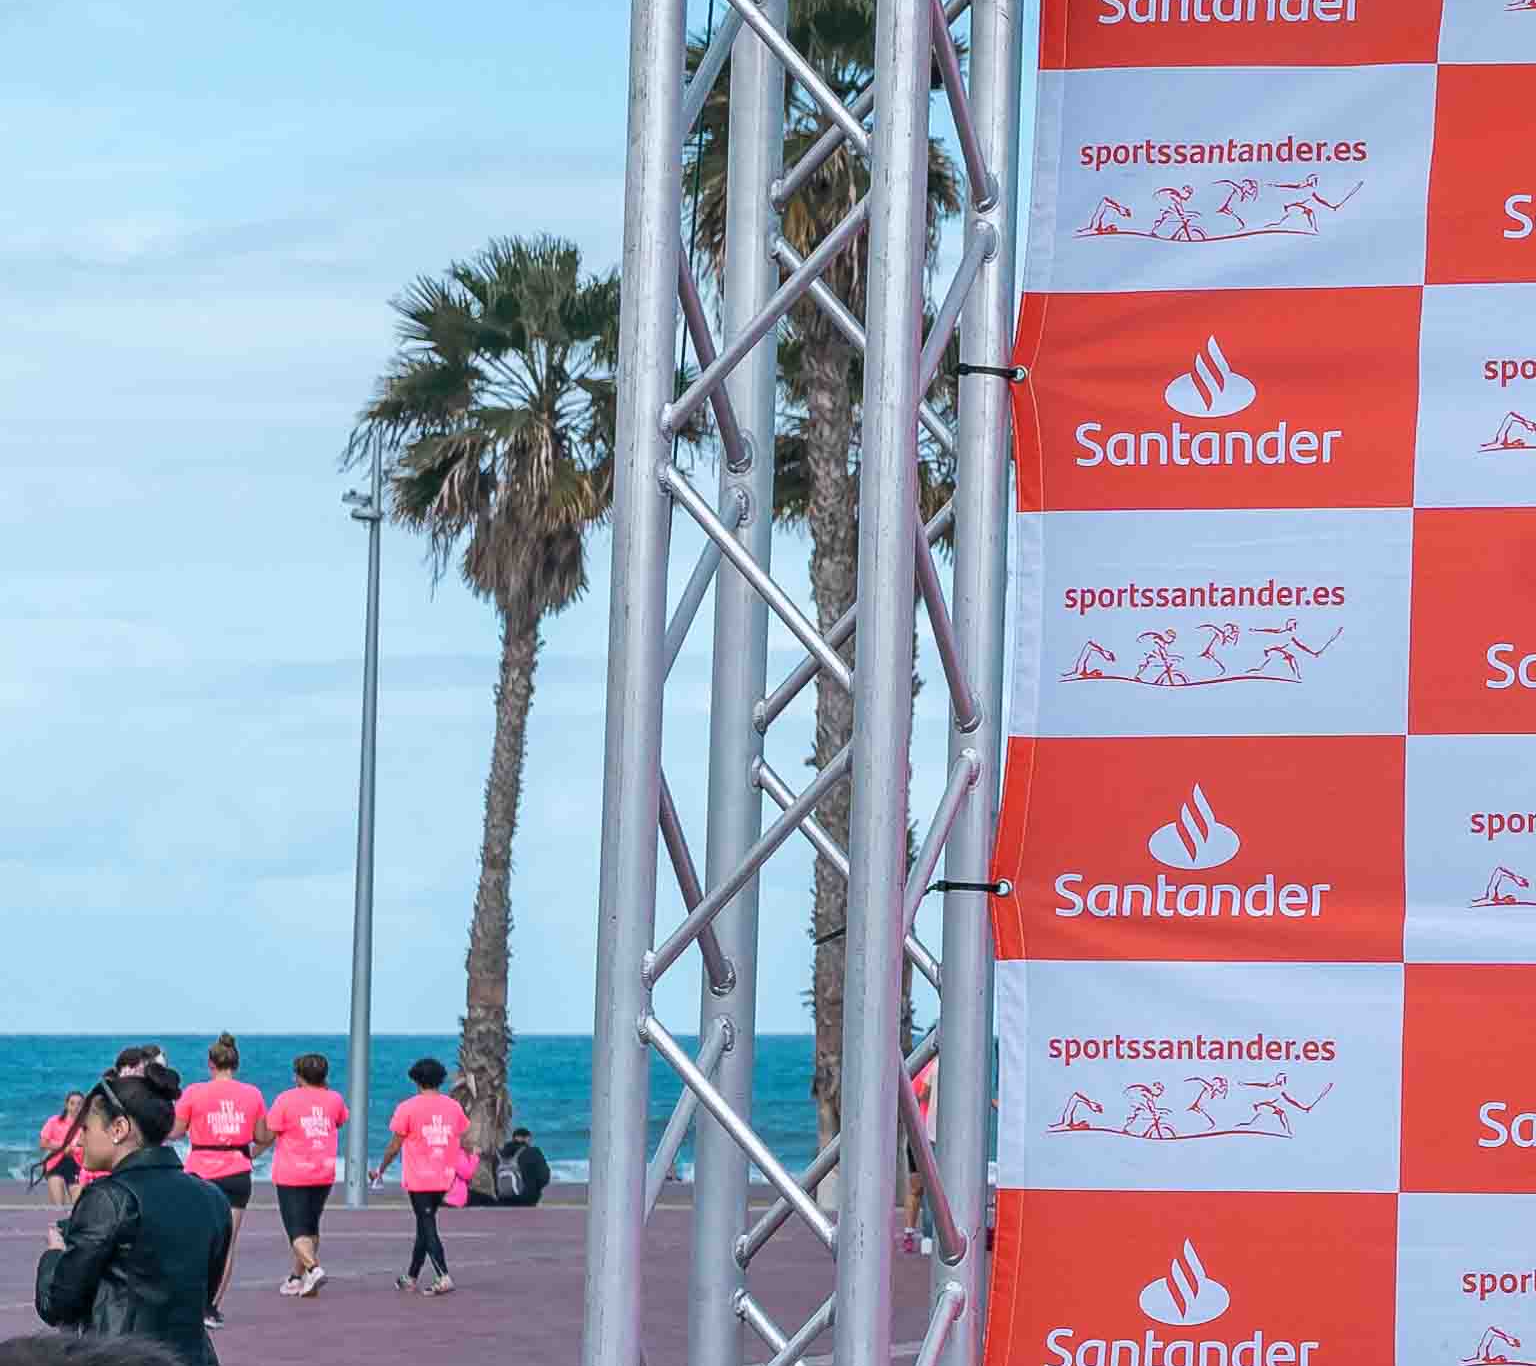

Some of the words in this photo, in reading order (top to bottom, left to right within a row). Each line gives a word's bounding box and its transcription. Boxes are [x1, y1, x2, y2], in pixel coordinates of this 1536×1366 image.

[1080, 135, 1367, 172] sportssantander.es
[1075, 421, 1342, 467] Santander
[1064, 578, 1345, 616] sportssantander.es
[1054, 873, 1331, 917] Santander
[1048, 1033, 1336, 1067] sportssantander.es
